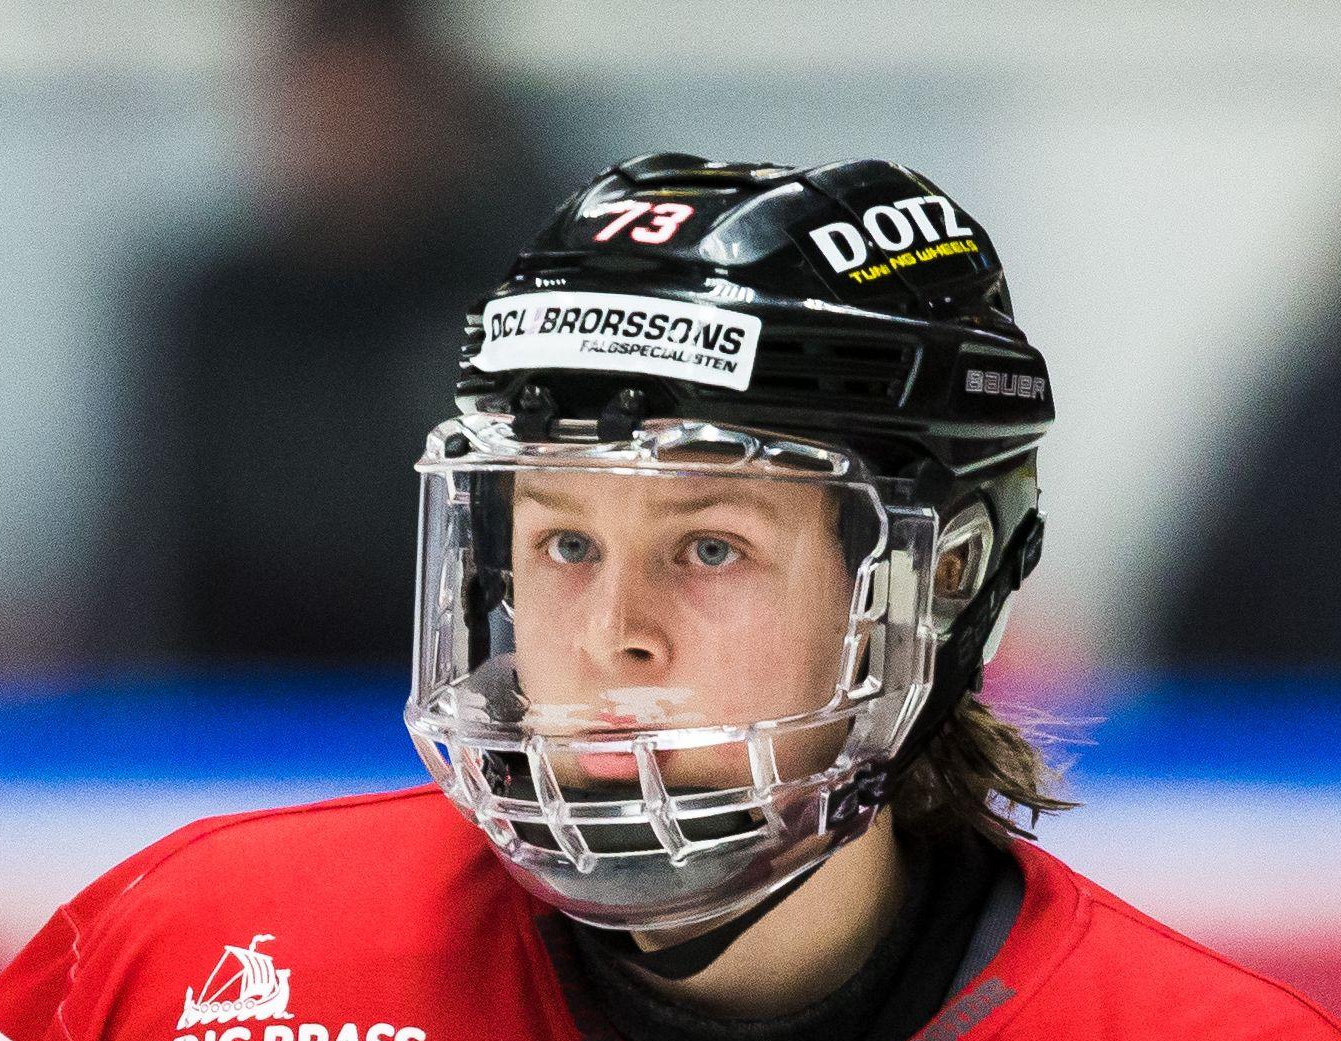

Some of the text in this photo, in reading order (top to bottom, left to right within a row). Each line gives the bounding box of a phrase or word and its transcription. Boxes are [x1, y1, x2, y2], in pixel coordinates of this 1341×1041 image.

[582, 199, 695, 245] 73
[809, 195, 974, 274] DOTZ
[538, 307, 745, 355] BRORSSONS
